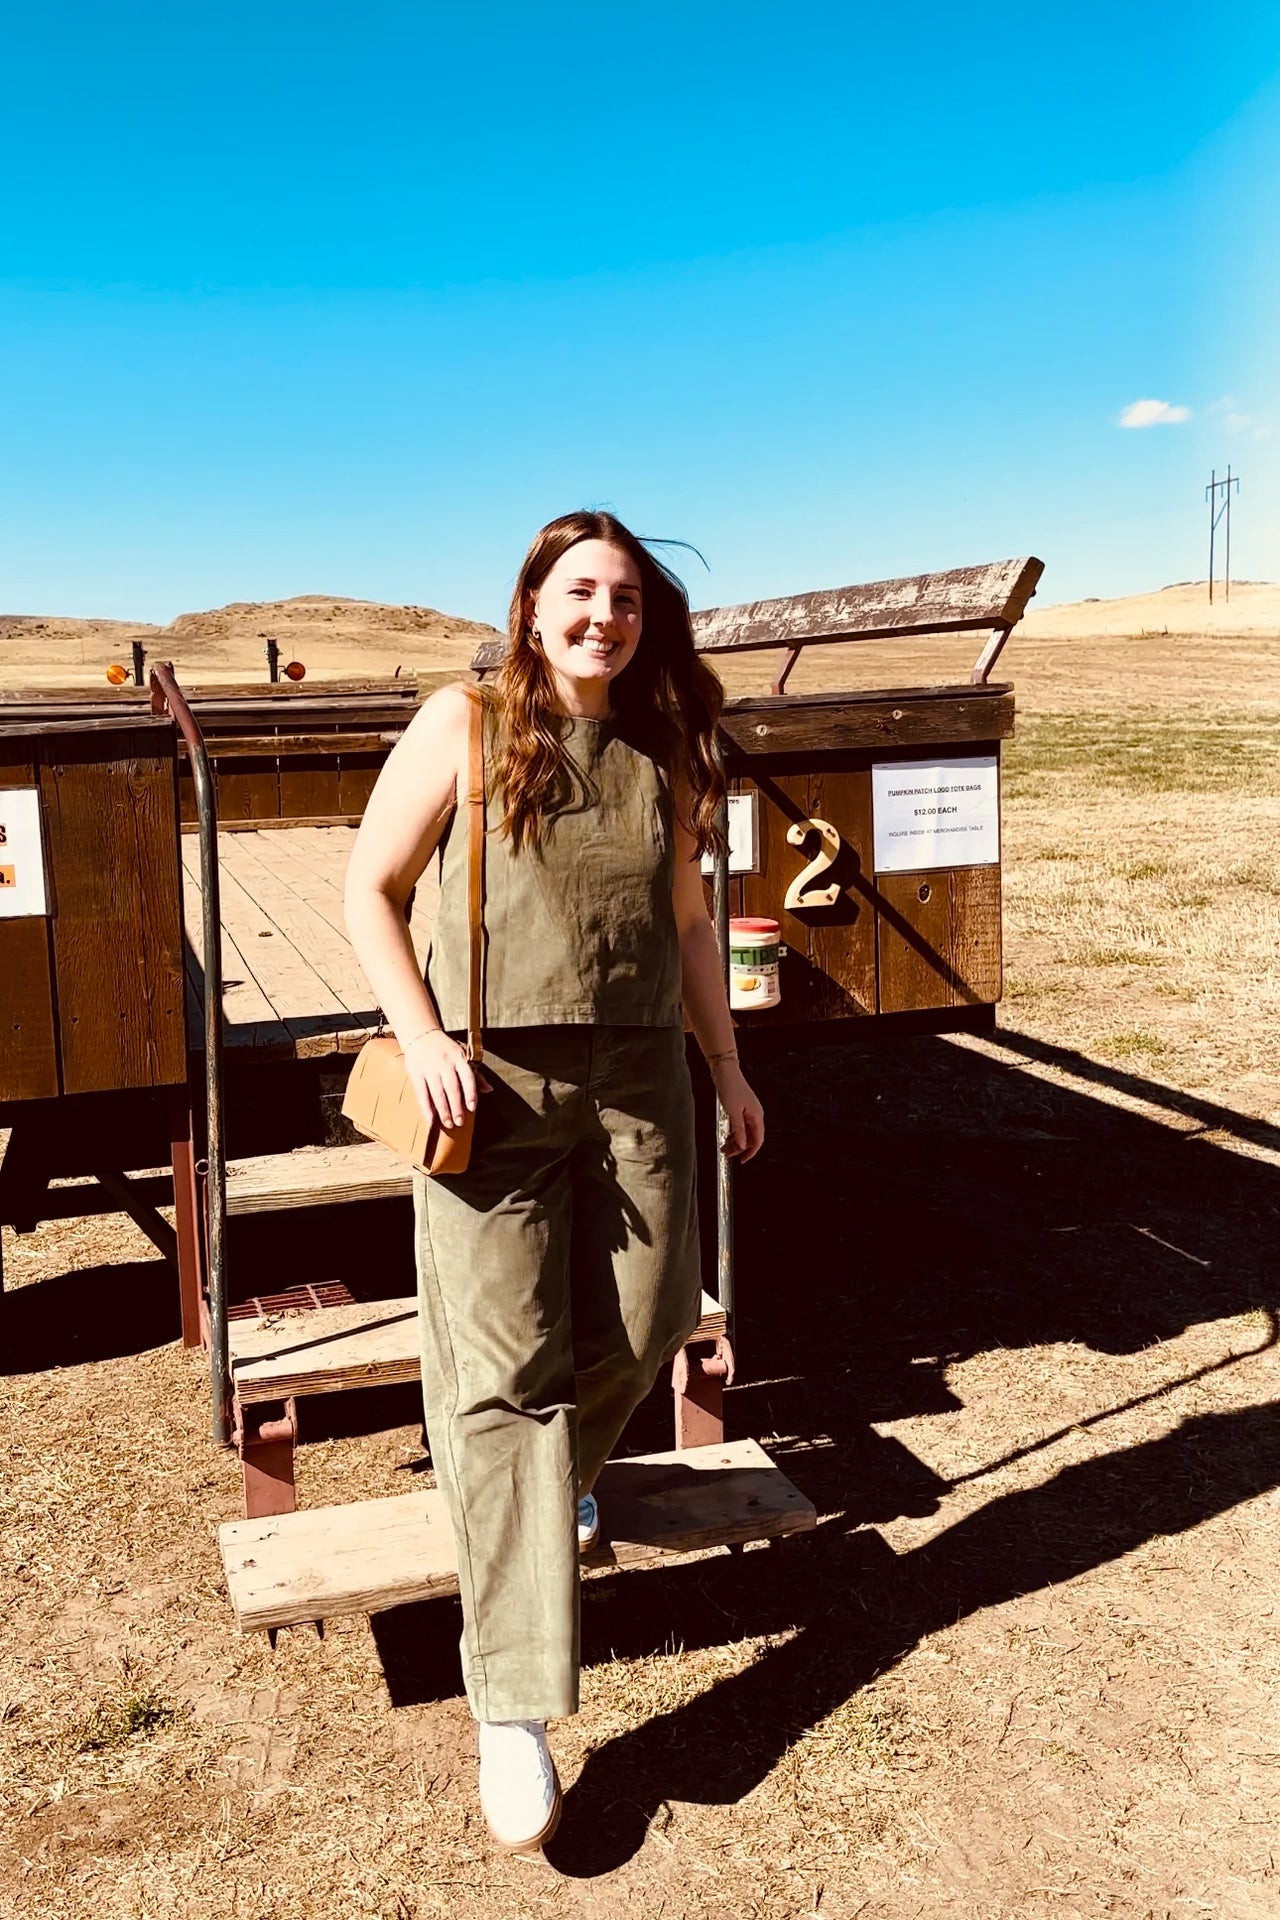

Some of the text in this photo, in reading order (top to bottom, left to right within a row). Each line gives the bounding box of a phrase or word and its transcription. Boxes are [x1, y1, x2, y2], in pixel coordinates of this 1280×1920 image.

[888, 789, 913, 797] PUMPKIN
[914, 806, 957, 816] $12.00 EACH
[783, 818, 841, 910] 2
[731, 946, 777, 967] TIPS
